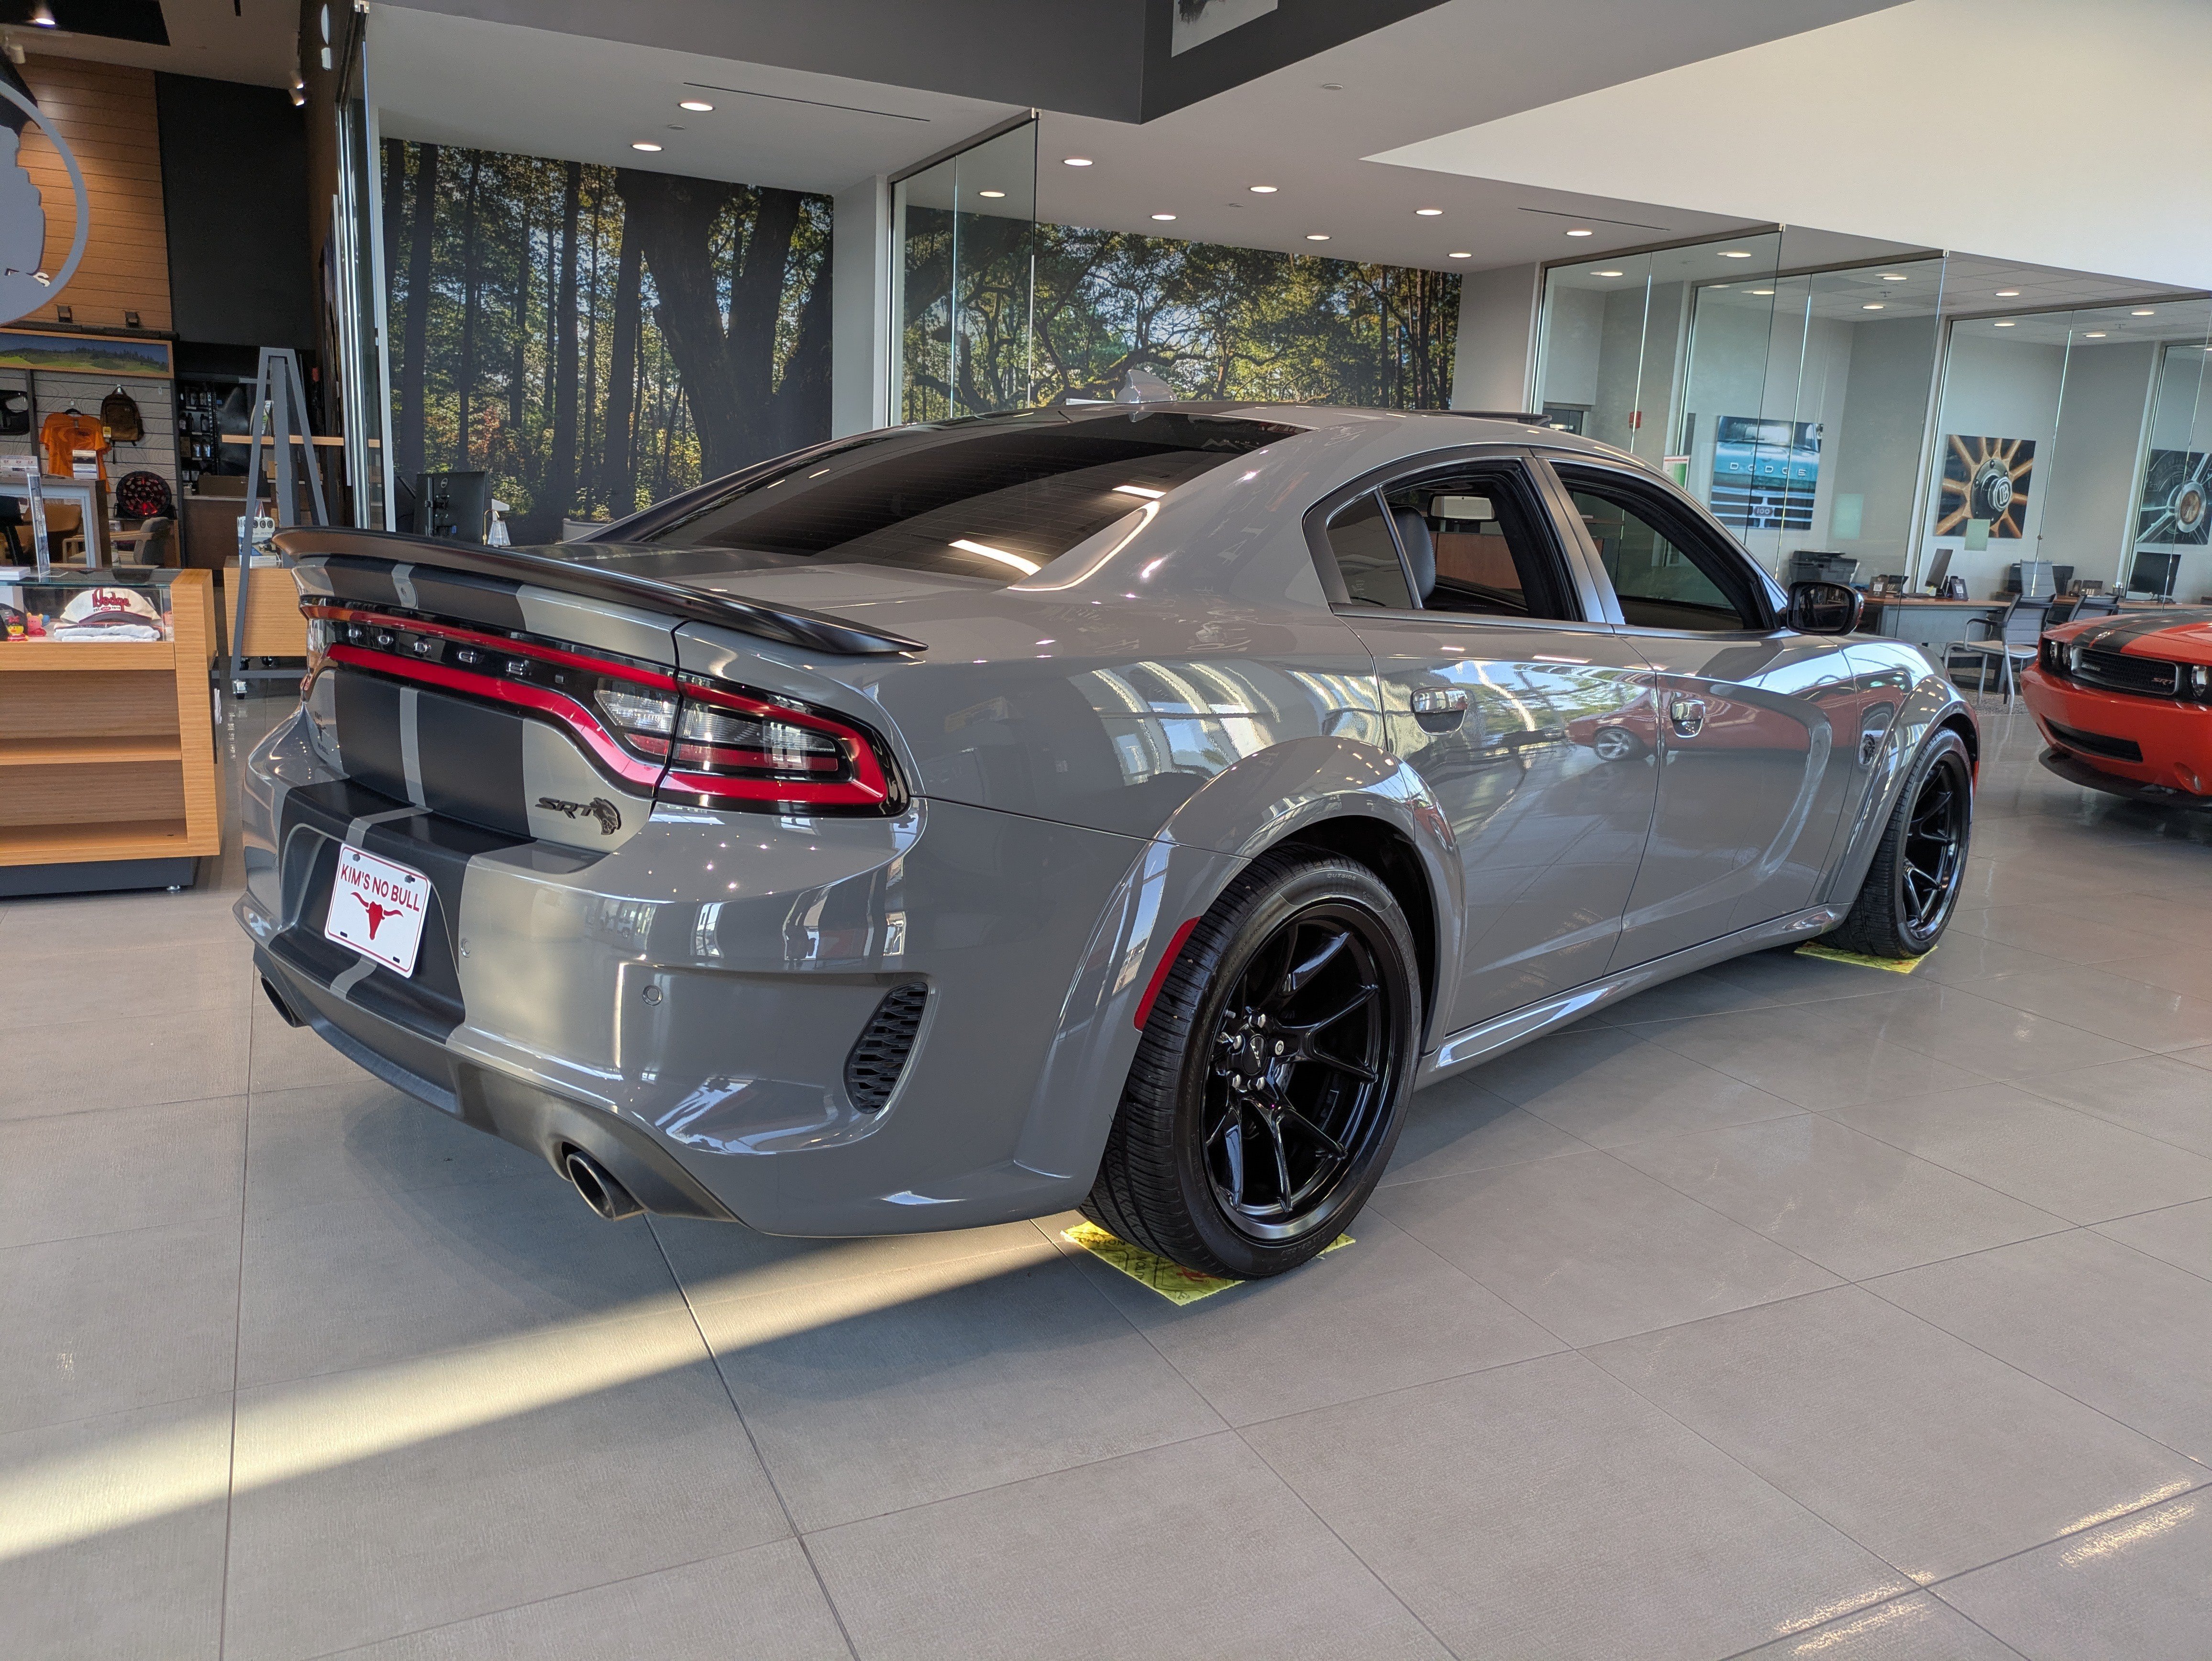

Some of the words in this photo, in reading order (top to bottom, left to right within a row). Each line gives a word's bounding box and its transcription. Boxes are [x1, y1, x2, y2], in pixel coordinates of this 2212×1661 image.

[1730, 462, 1806, 476] DODGE
[92, 587, 131, 612] Dodge
[348, 629, 524, 675] DODGE
[2151, 677, 2175, 686] SRT
[535, 797, 593, 819] SRT
[341, 864, 370, 890] KIM'S
[372, 877, 389, 897] NO
[390, 885, 420, 912] BULL
[1250, 1043, 1261, 1068] SRT
